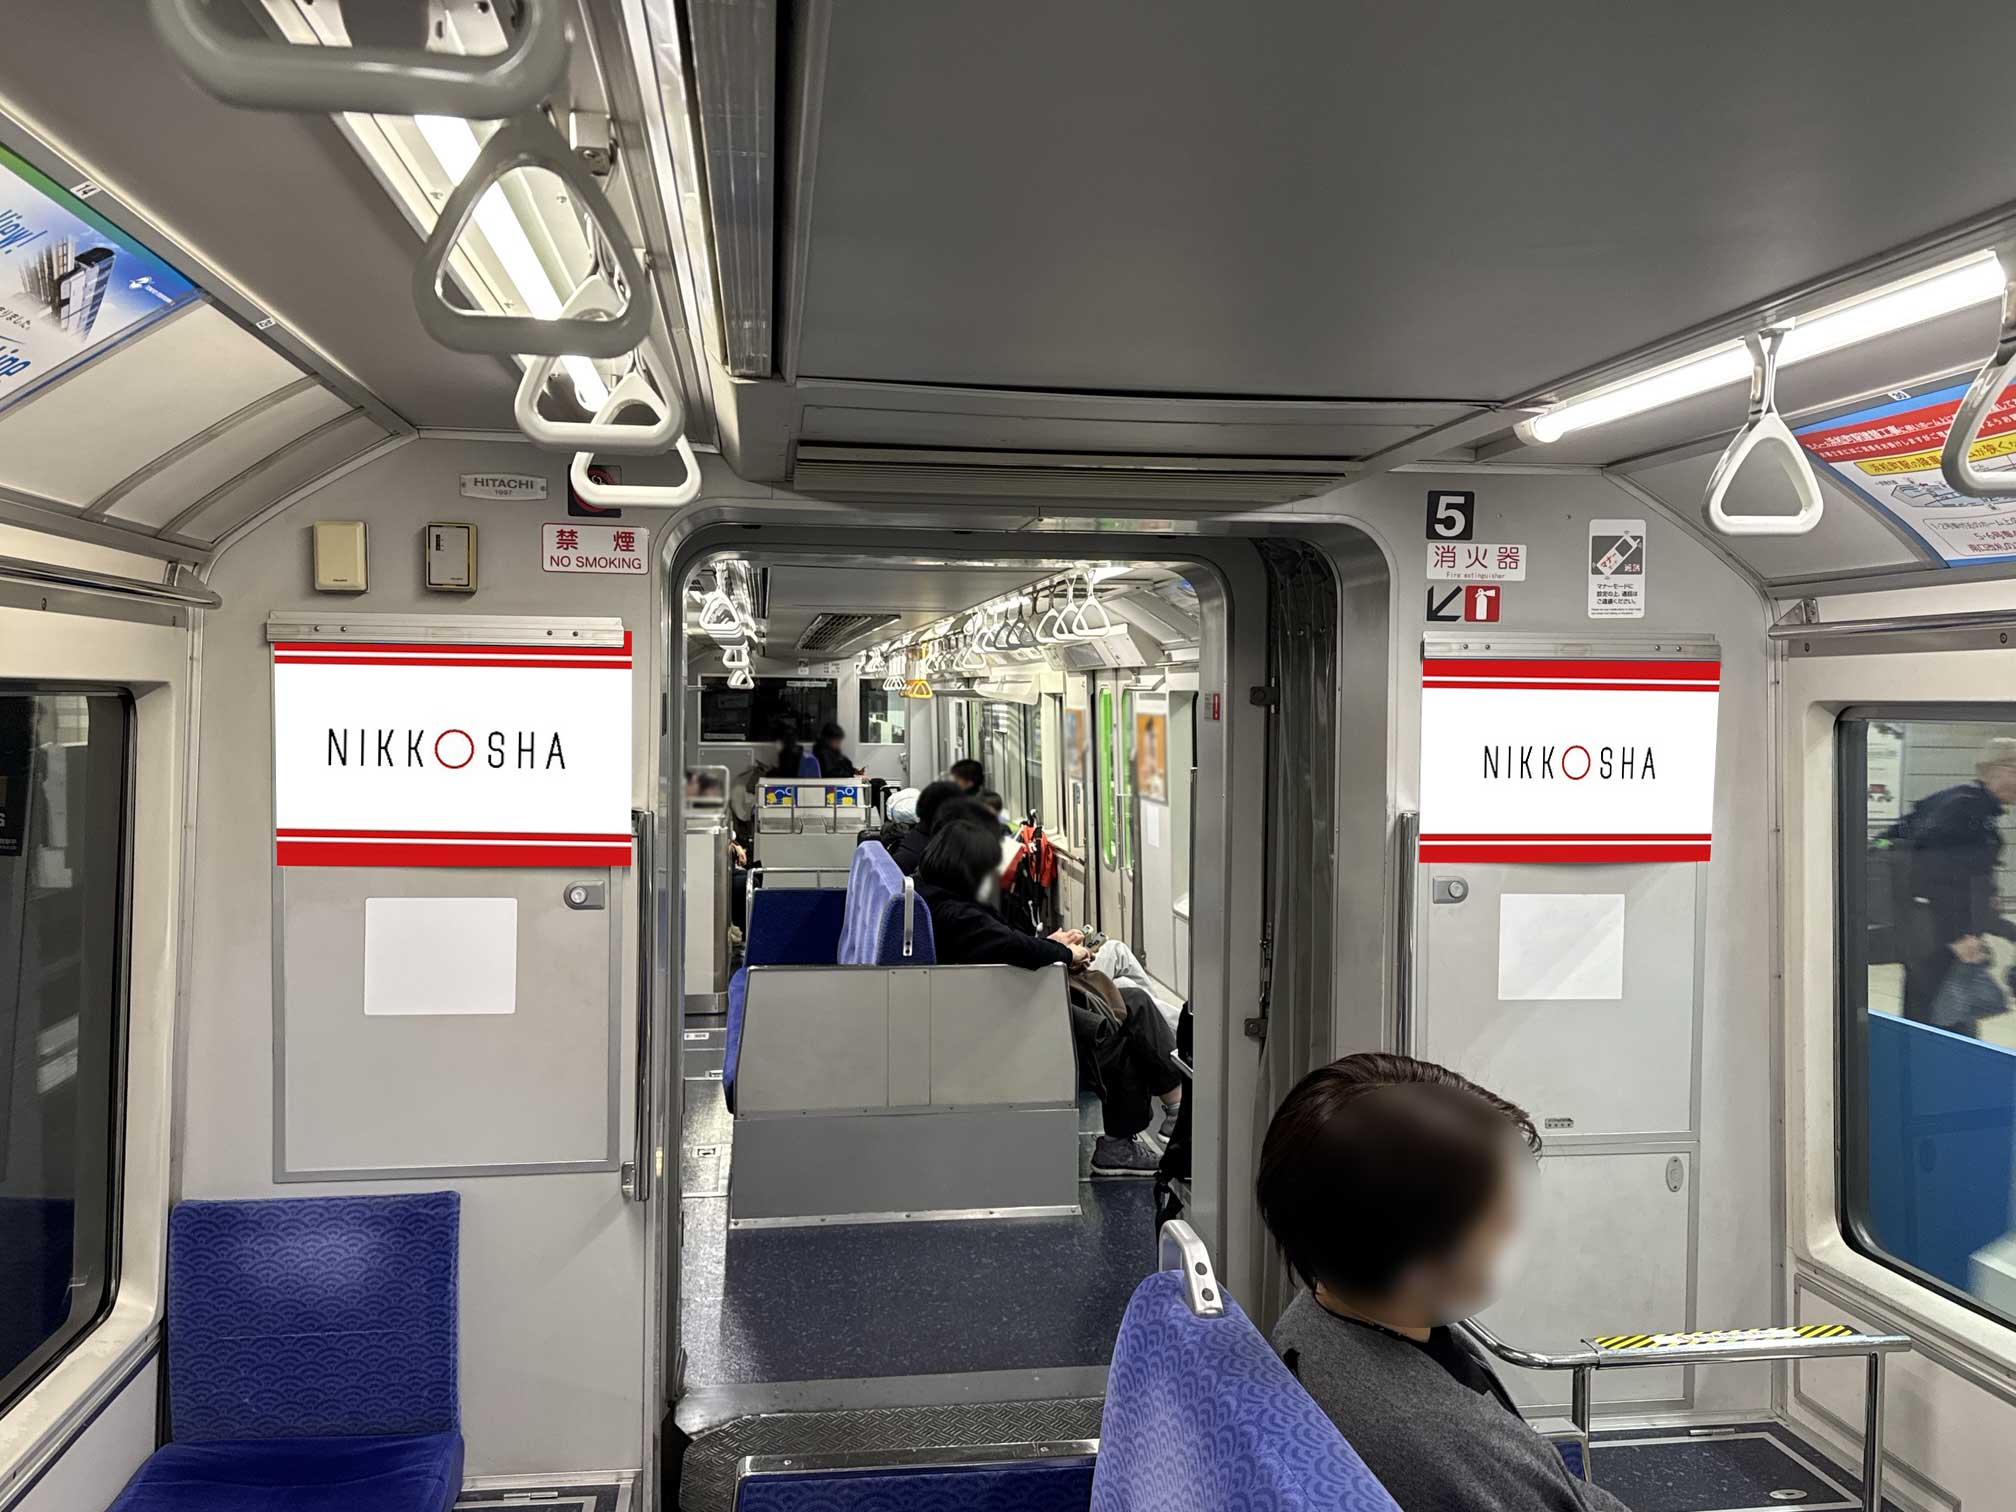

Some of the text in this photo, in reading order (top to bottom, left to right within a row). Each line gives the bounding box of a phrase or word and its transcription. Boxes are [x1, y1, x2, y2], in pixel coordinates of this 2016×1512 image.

[473, 477, 535, 489] HITACHI
[1434, 495, 1467, 538] 5
[555, 528, 637, 553] 禁煙
[549, 554, 642, 571] NO SMOKING
[1433, 544, 1520, 570] 消火器
[1446, 571, 1461, 579] Fire
[328, 728, 566, 770] NIKKOSHA
[1484, 745, 1656, 781] NIKKOSHA
